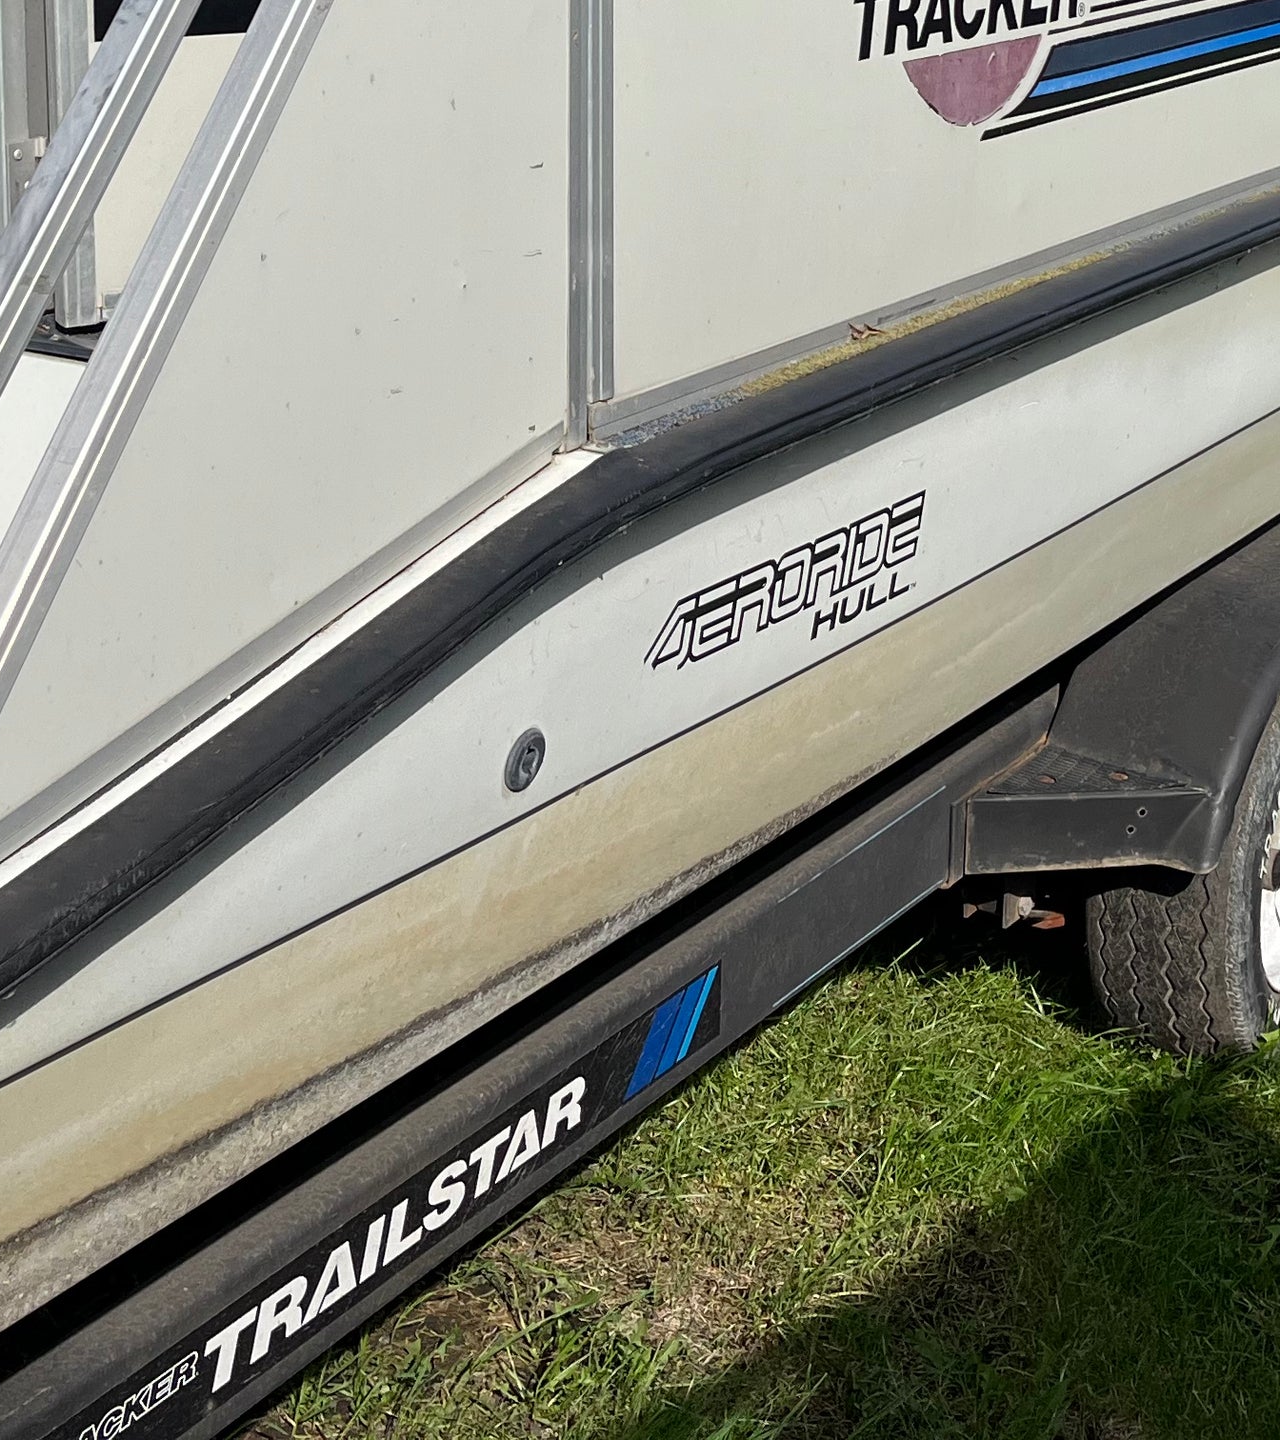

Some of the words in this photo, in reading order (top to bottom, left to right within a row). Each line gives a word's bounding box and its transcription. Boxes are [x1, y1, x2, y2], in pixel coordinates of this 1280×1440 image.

[643, 489, 927, 671] AERORIDE
[810, 571, 910, 641] HULL
[204, 1075, 587, 1394] TRAILSTAR
